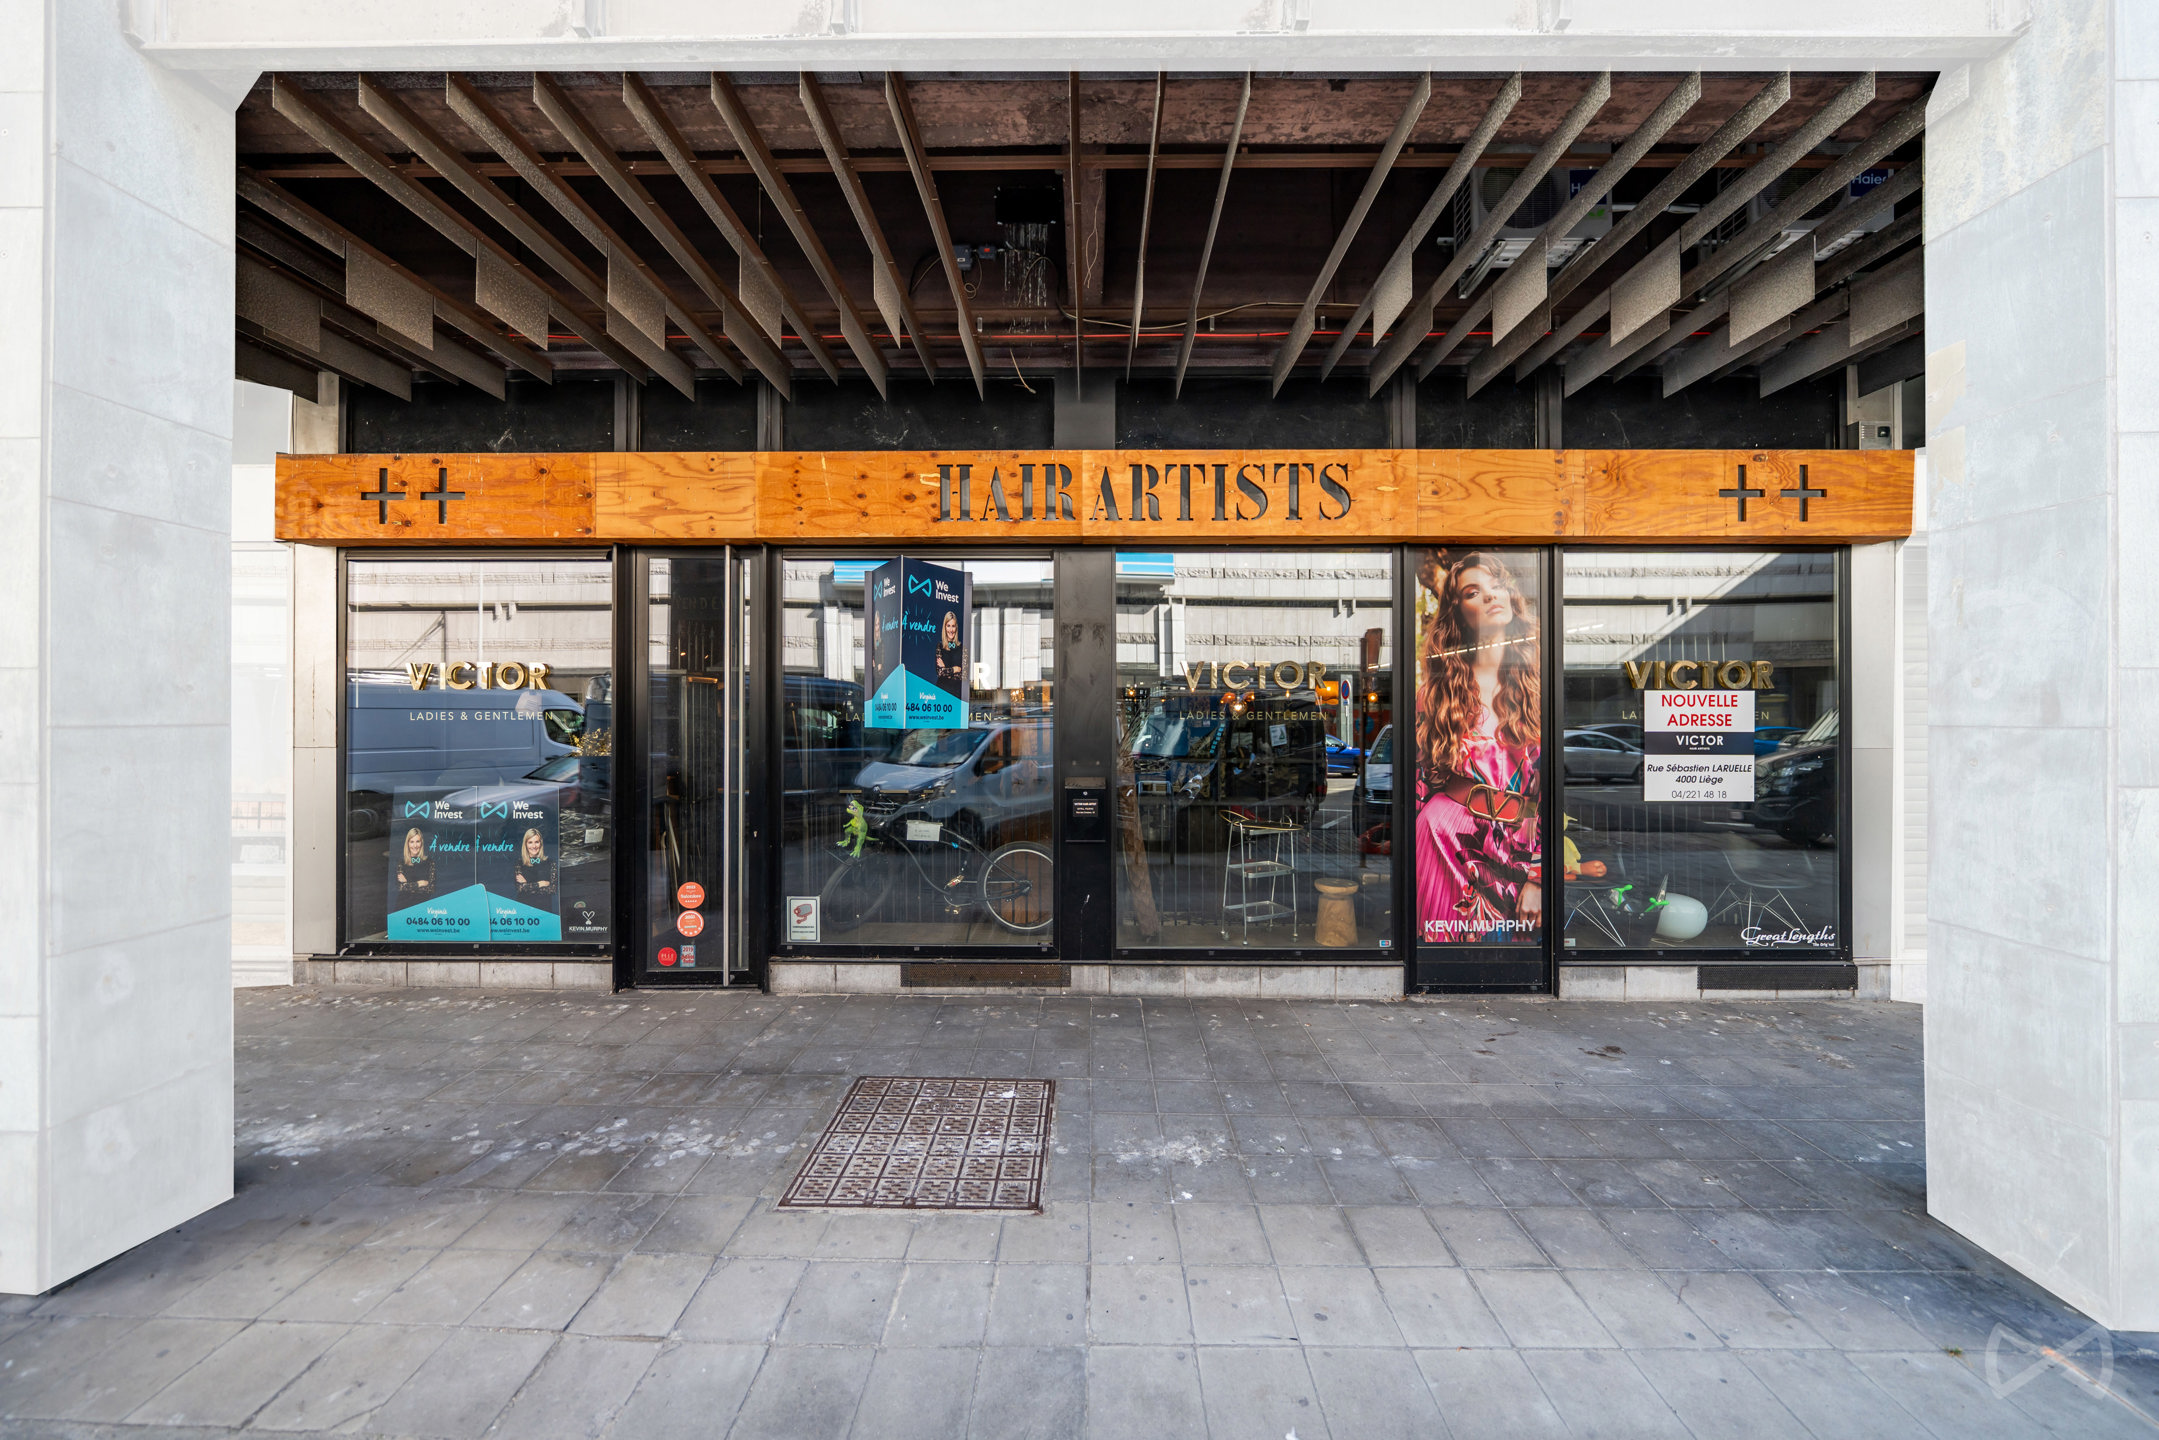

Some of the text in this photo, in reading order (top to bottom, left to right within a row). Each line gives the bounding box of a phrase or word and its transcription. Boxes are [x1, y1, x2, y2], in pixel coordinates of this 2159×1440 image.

[936, 463, 1352, 522] HAIR ARTISTS
[935, 580, 949, 592] We
[935, 589, 960, 604] Invest
[909, 619, 937, 634] vendre
[405, 661, 551, 691] VICTOR
[1179, 660, 1328, 690] VICTOR
[1624, 660, 1775, 690] VICTOR
[1661, 694, 1738, 708] NOUVELLE
[922, 703, 932, 712] 06
[933, 703, 941, 713] 10
[943, 704, 953, 713] 00
[410, 711, 553, 721] LADIES & GENTLEMEN
[1179, 711, 1328, 721] LADIES & GENTLEMEN
[1667, 713, 1732, 727] ADRESSE
[1676, 735, 1724, 746] VICTOR
[1647, 763, 1752, 773] Rue Sébastien LARUELLE
[1675, 774, 1724, 786] 4000 Liège
[1671, 790, 1727, 799] 04/221 48 18
[434, 800, 450, 810] We
[513, 800, 529, 810] We
[434, 810, 463, 819] Invest
[513, 810, 544, 819] Invest
[429, 834, 470, 853] À vendre
[482, 840, 514, 852] vendre
[406, 917, 470, 926] 0484 06 10 00
[500, 918, 512, 926] 06
[514, 918, 525, 926] 10
[527, 918, 540, 926] 00
[1424, 919, 1536, 932] KEVIN.MURPHY
[1741, 926, 1788, 946] Great
